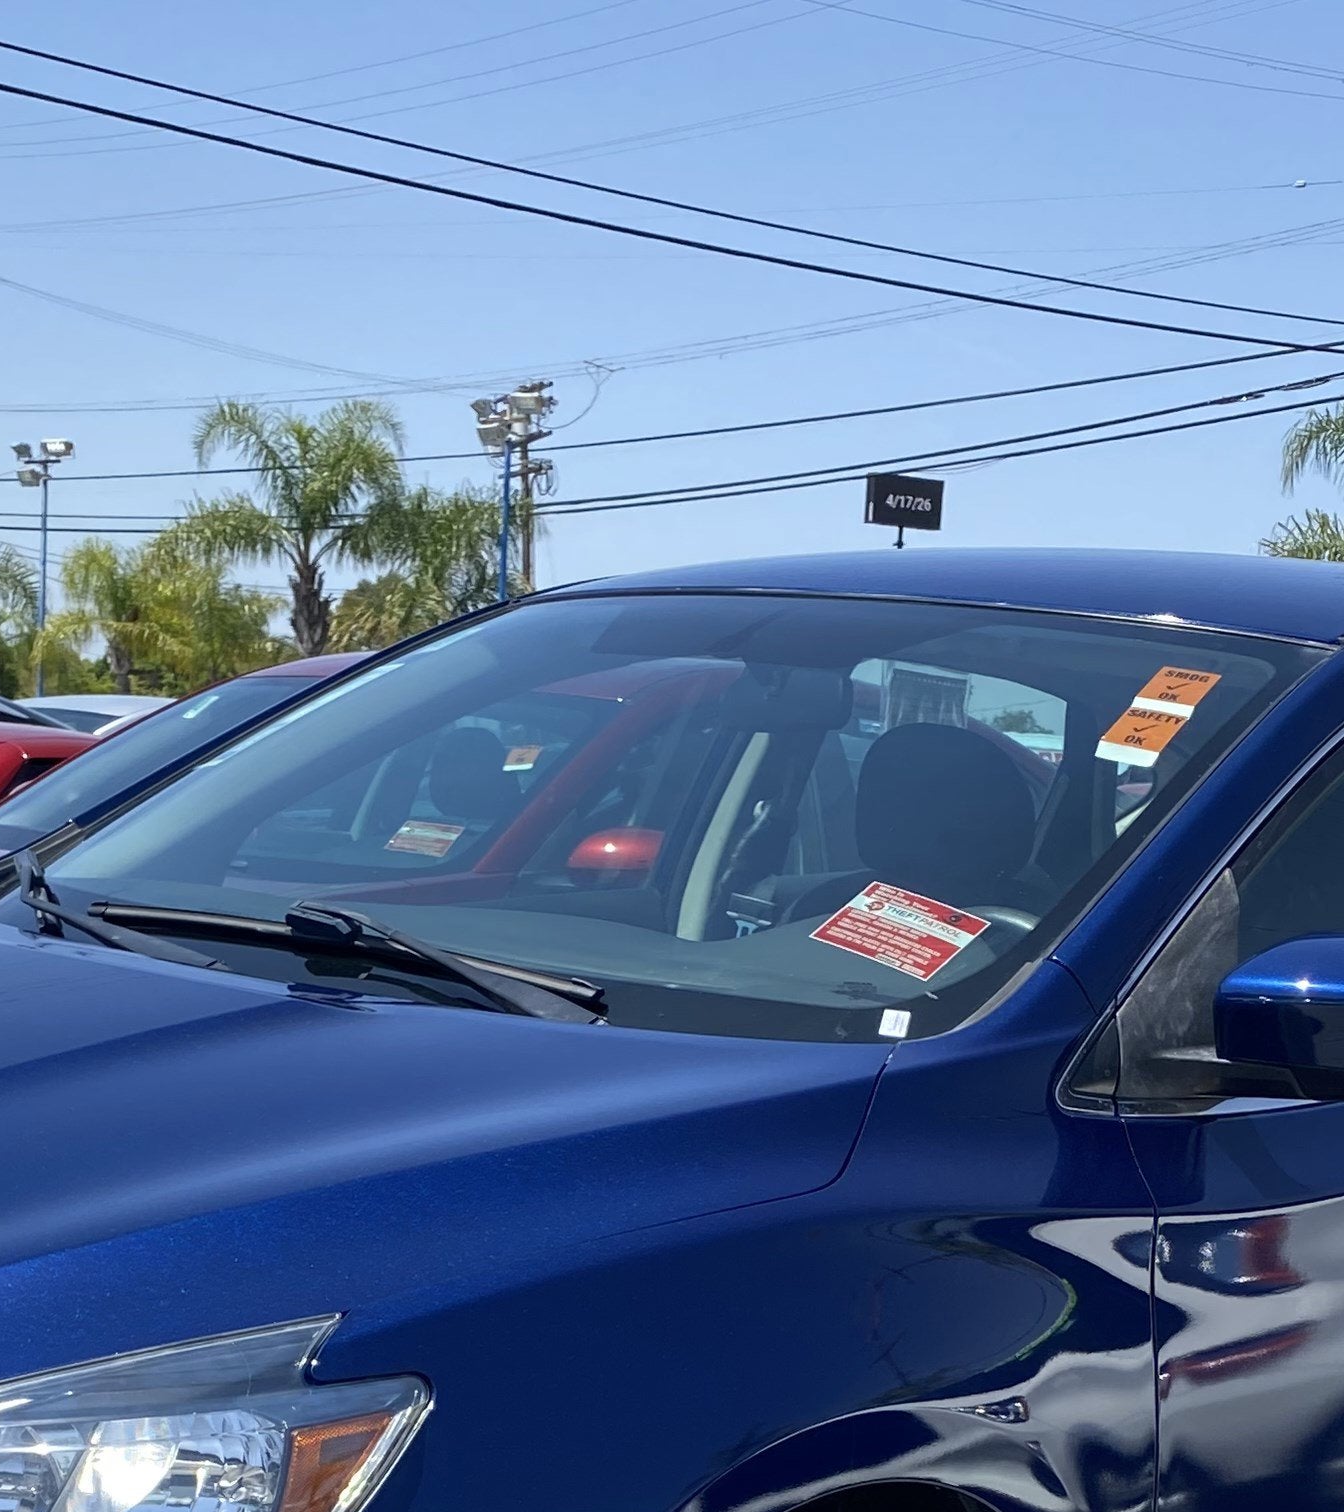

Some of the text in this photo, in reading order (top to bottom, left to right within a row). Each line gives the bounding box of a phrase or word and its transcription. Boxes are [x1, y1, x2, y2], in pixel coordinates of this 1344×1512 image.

[885, 493, 932, 512] 4/17/26
[1164, 670, 1210, 683] SMOG
[1158, 692, 1180, 701] OK
[1127, 709, 1187, 725] SAFETY
[1124, 735, 1146, 746] OK
